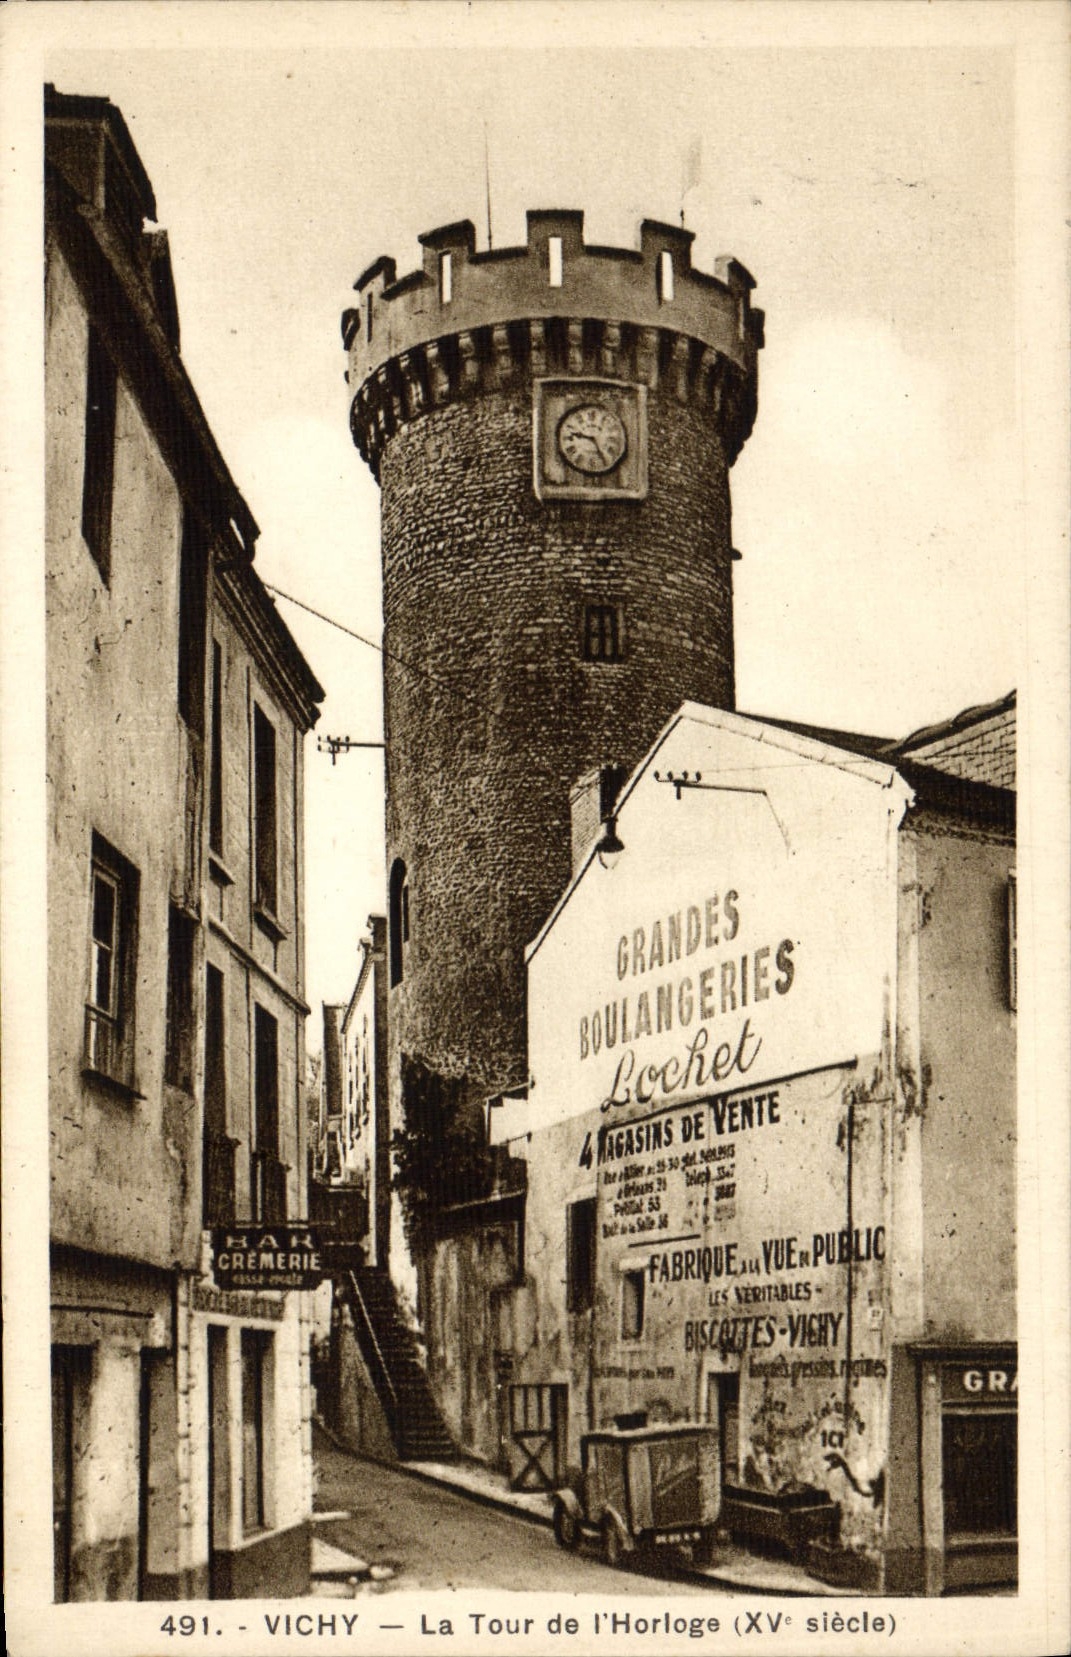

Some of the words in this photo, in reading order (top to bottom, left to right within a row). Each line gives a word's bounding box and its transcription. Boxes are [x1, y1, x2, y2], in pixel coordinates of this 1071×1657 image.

[617, 889, 740, 981] GRANDES
[580, 938, 795, 1061] BOULANGERIES
[578, 1131, 593, 1170] 4
[597, 1126, 673, 1167] MAGASINS
[681, 1112, 705, 1143] DE
[708, 1090, 780, 1135] VENTE
[226, 1234, 314, 1249] BAR
[649, 1243, 738, 1284] FABRIQUE
[762, 1237, 798, 1275] VUE
[813, 1226, 886, 1267] PUBLIC
[708, 1289, 728, 1307] LES
